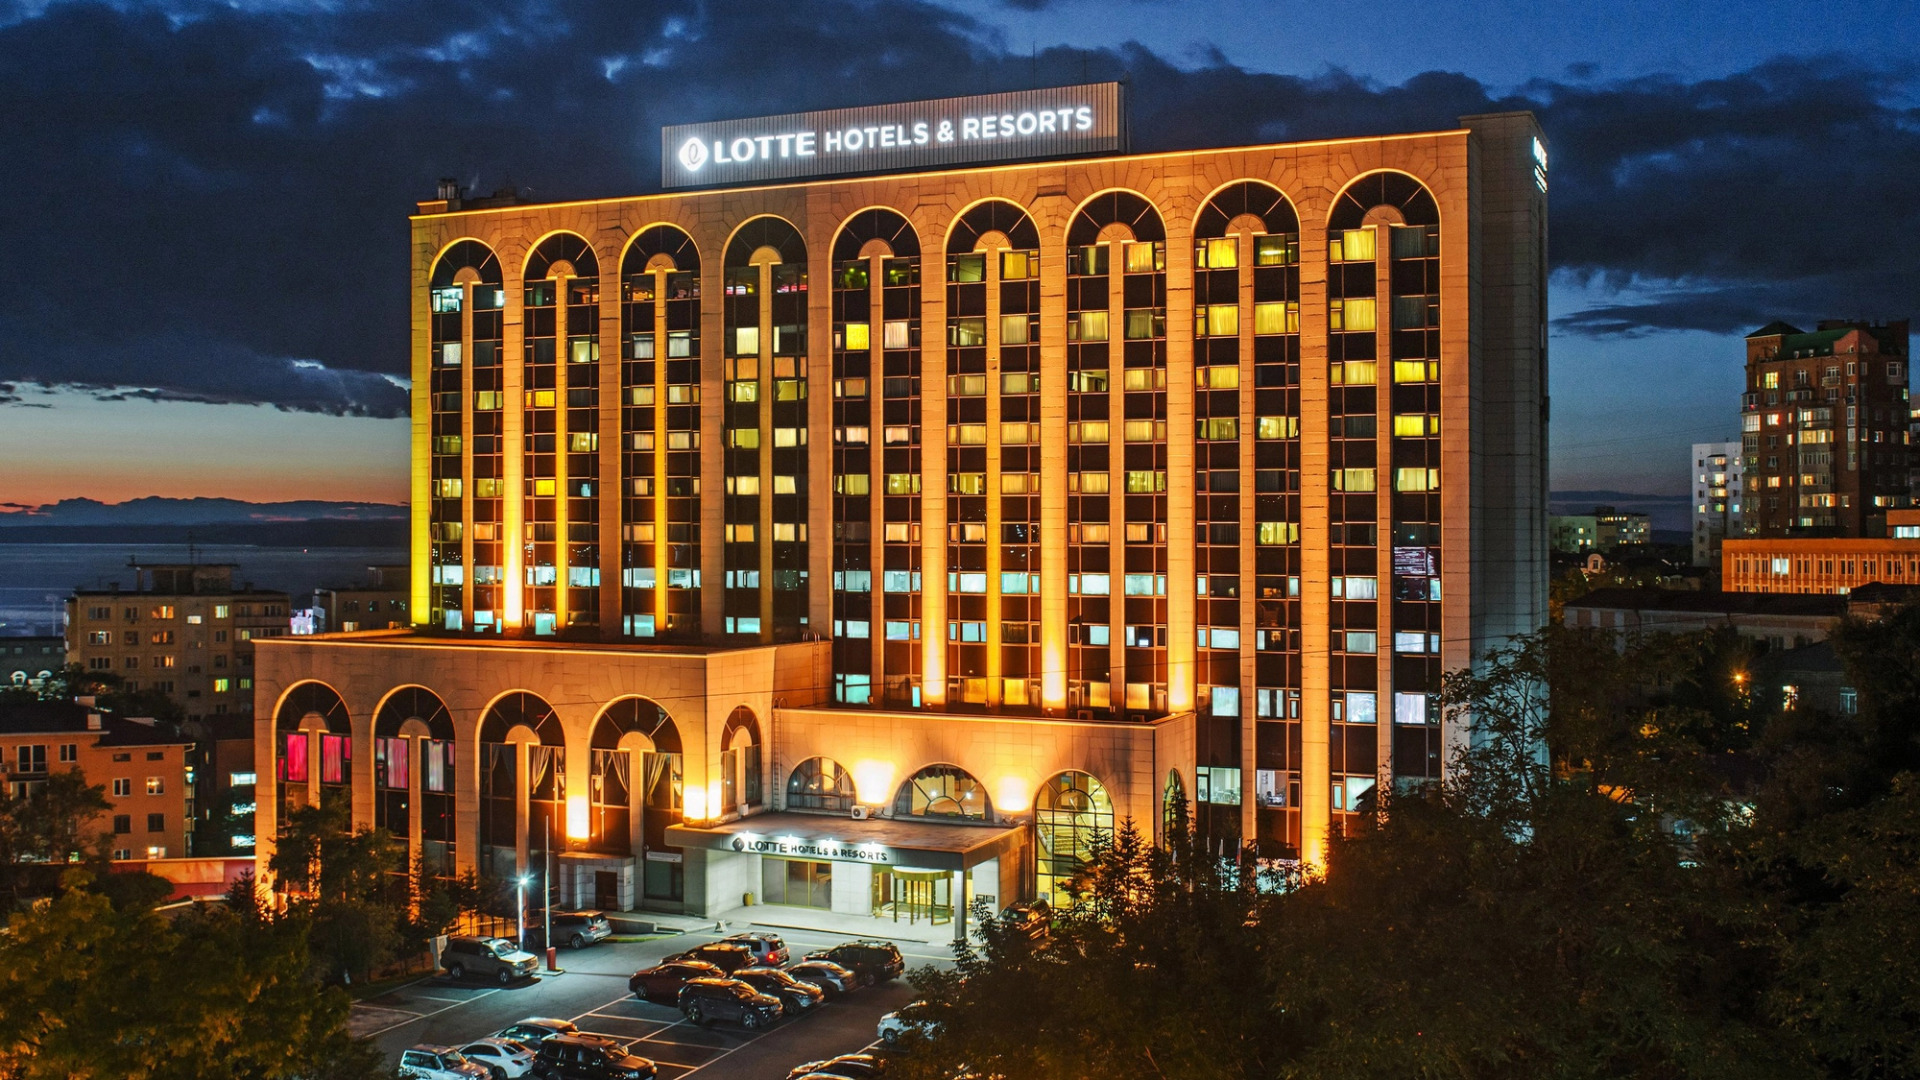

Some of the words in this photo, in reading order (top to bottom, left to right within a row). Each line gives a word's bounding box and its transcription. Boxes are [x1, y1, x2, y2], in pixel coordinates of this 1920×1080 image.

[714, 130, 816, 164] LOTTE
[825, 122, 929, 153] HOTELS
[937, 120, 954, 143] &
[962, 106, 1093, 140] RESORTS
[748, 841, 787, 854] LOTTE
[791, 844, 829, 856] HOTELS
[841, 848, 888, 861] RESORTS
